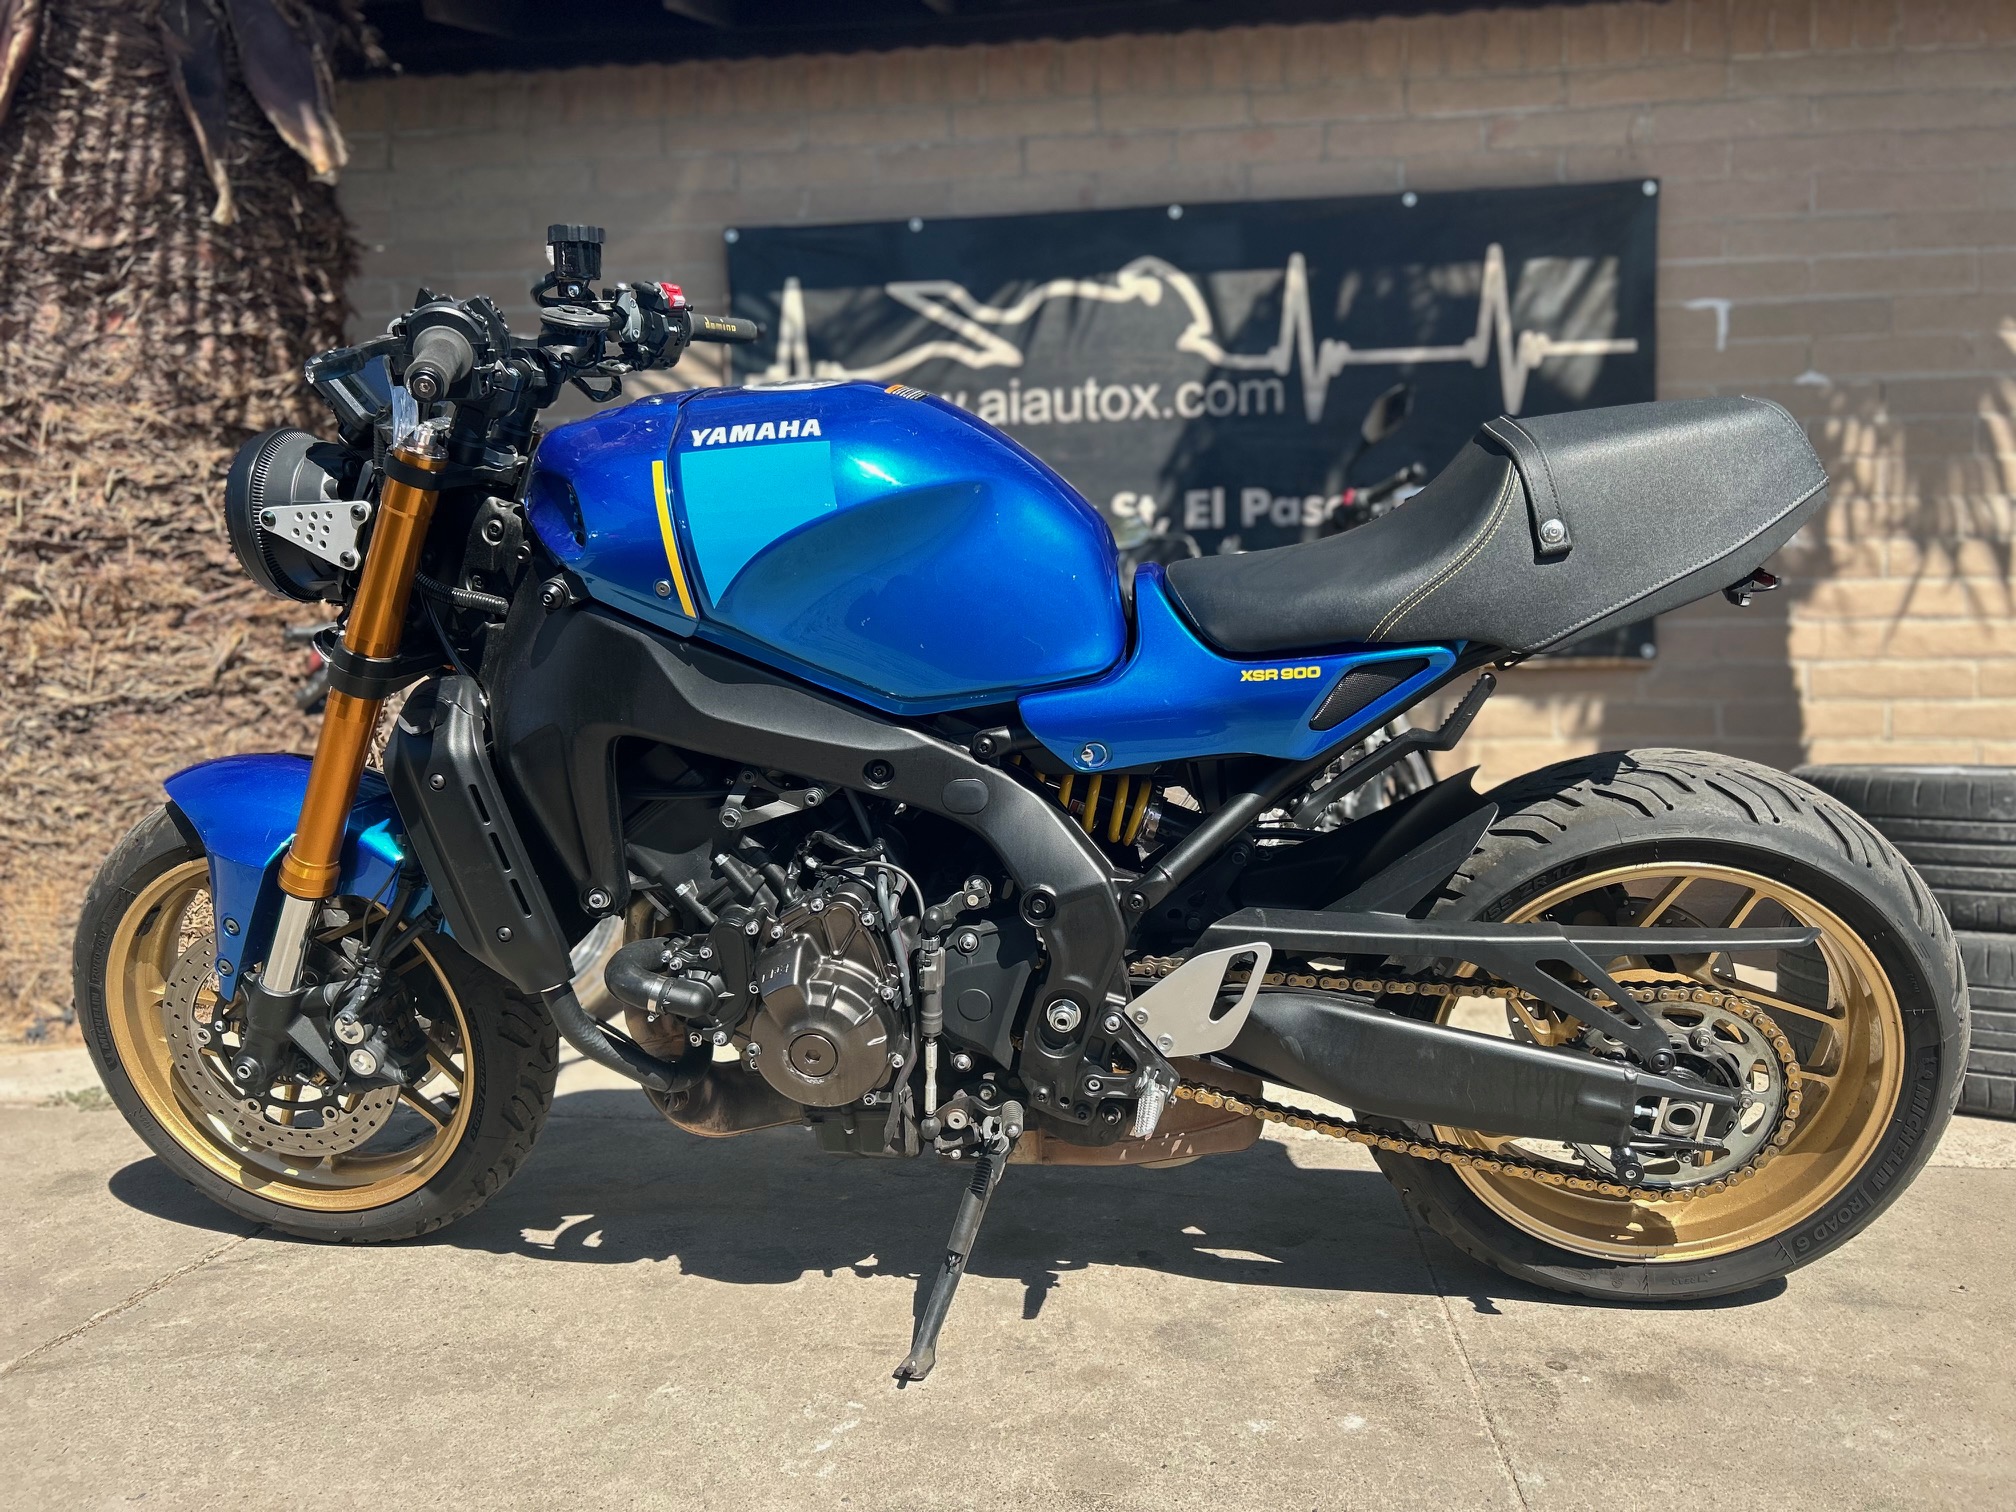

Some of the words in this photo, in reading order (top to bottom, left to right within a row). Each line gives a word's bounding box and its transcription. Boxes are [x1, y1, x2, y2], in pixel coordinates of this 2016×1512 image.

[704, 316, 736, 332] domino
[691, 418, 822, 447] YAMAHA
[1183, 487, 1226, 530] El
[1240, 668, 1278, 682] XSR
[1280, 666, 1321, 680] 900
[91, 992, 110, 1051] MICHELIN
[1869, 1084, 1932, 1192] MICHELIN
[1813, 1199, 1865, 1240] ROAD
[1796, 1238, 1811, 1251] 6
